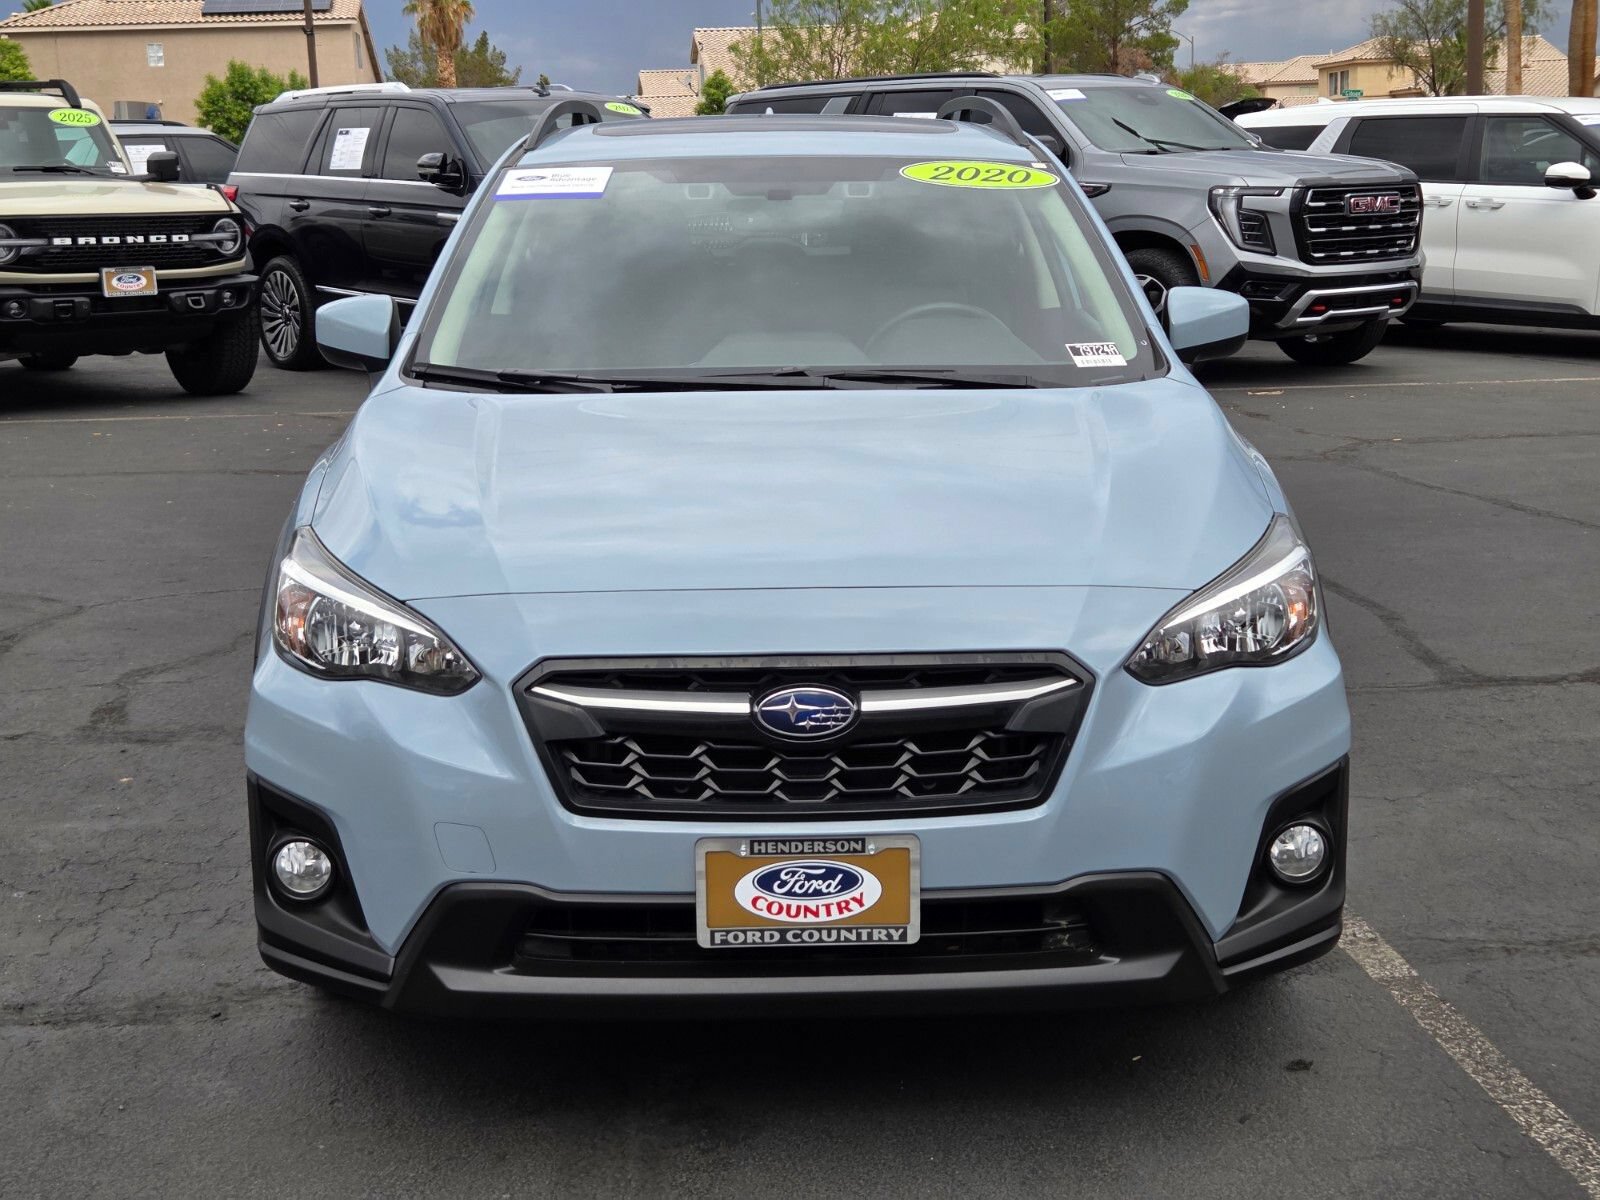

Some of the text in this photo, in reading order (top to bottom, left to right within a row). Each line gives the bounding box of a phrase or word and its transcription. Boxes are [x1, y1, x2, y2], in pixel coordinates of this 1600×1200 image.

[59, 112, 92, 123] 2025
[929, 165, 1031, 184] 2020
[1350, 196, 1399, 213] GMC
[53, 234, 189, 245] BRONCO
[753, 839, 863, 854] HENDERSON
[773, 868, 843, 894] Ford
[751, 892, 865, 919] COUNTRY
[714, 928, 904, 944] FORD COUNTRY
